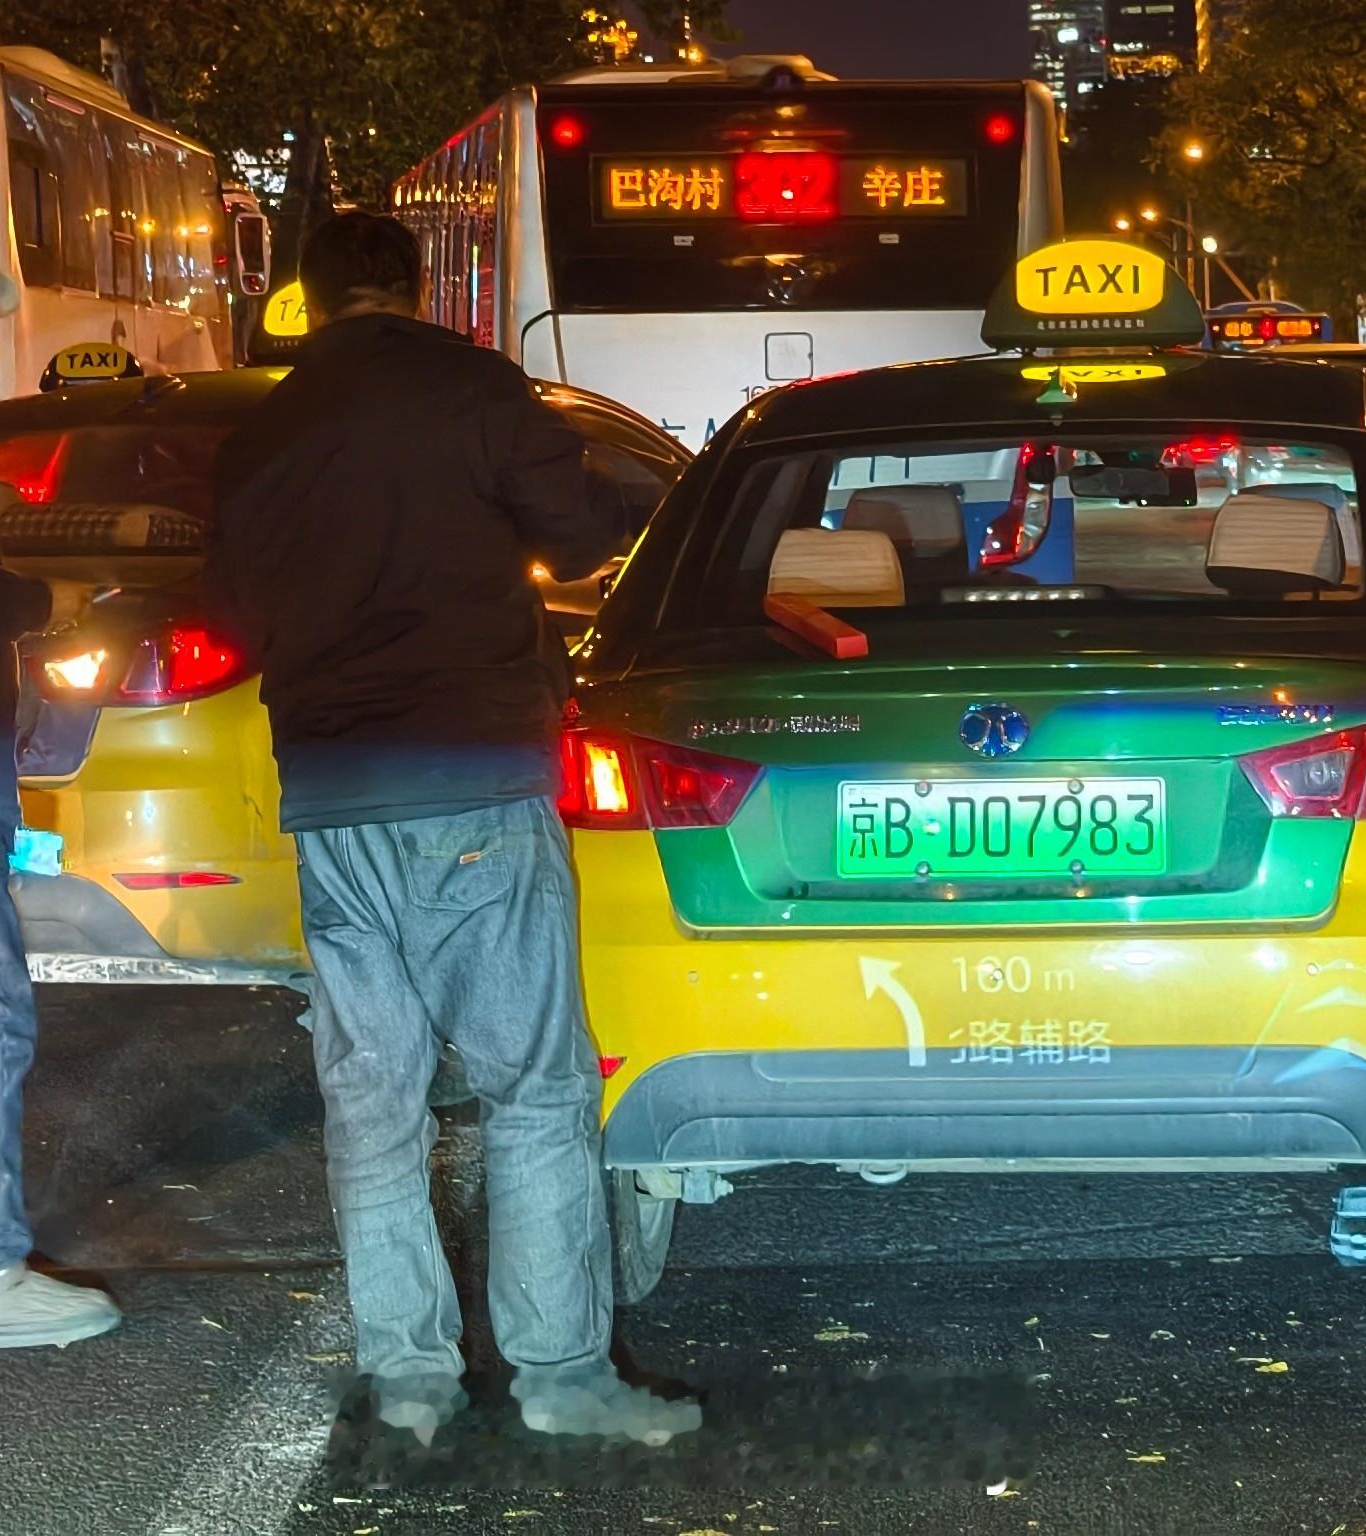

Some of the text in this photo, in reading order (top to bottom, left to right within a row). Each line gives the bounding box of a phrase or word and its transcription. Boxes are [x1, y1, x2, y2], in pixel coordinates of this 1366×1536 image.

[610, 167, 724, 210] 巴沟村
[862, 165, 946, 208] 辛庄
[1035, 264, 1140, 297] TAXI
[66, 351, 119, 370] TAXI
[1044, 969, 1075, 992] m
